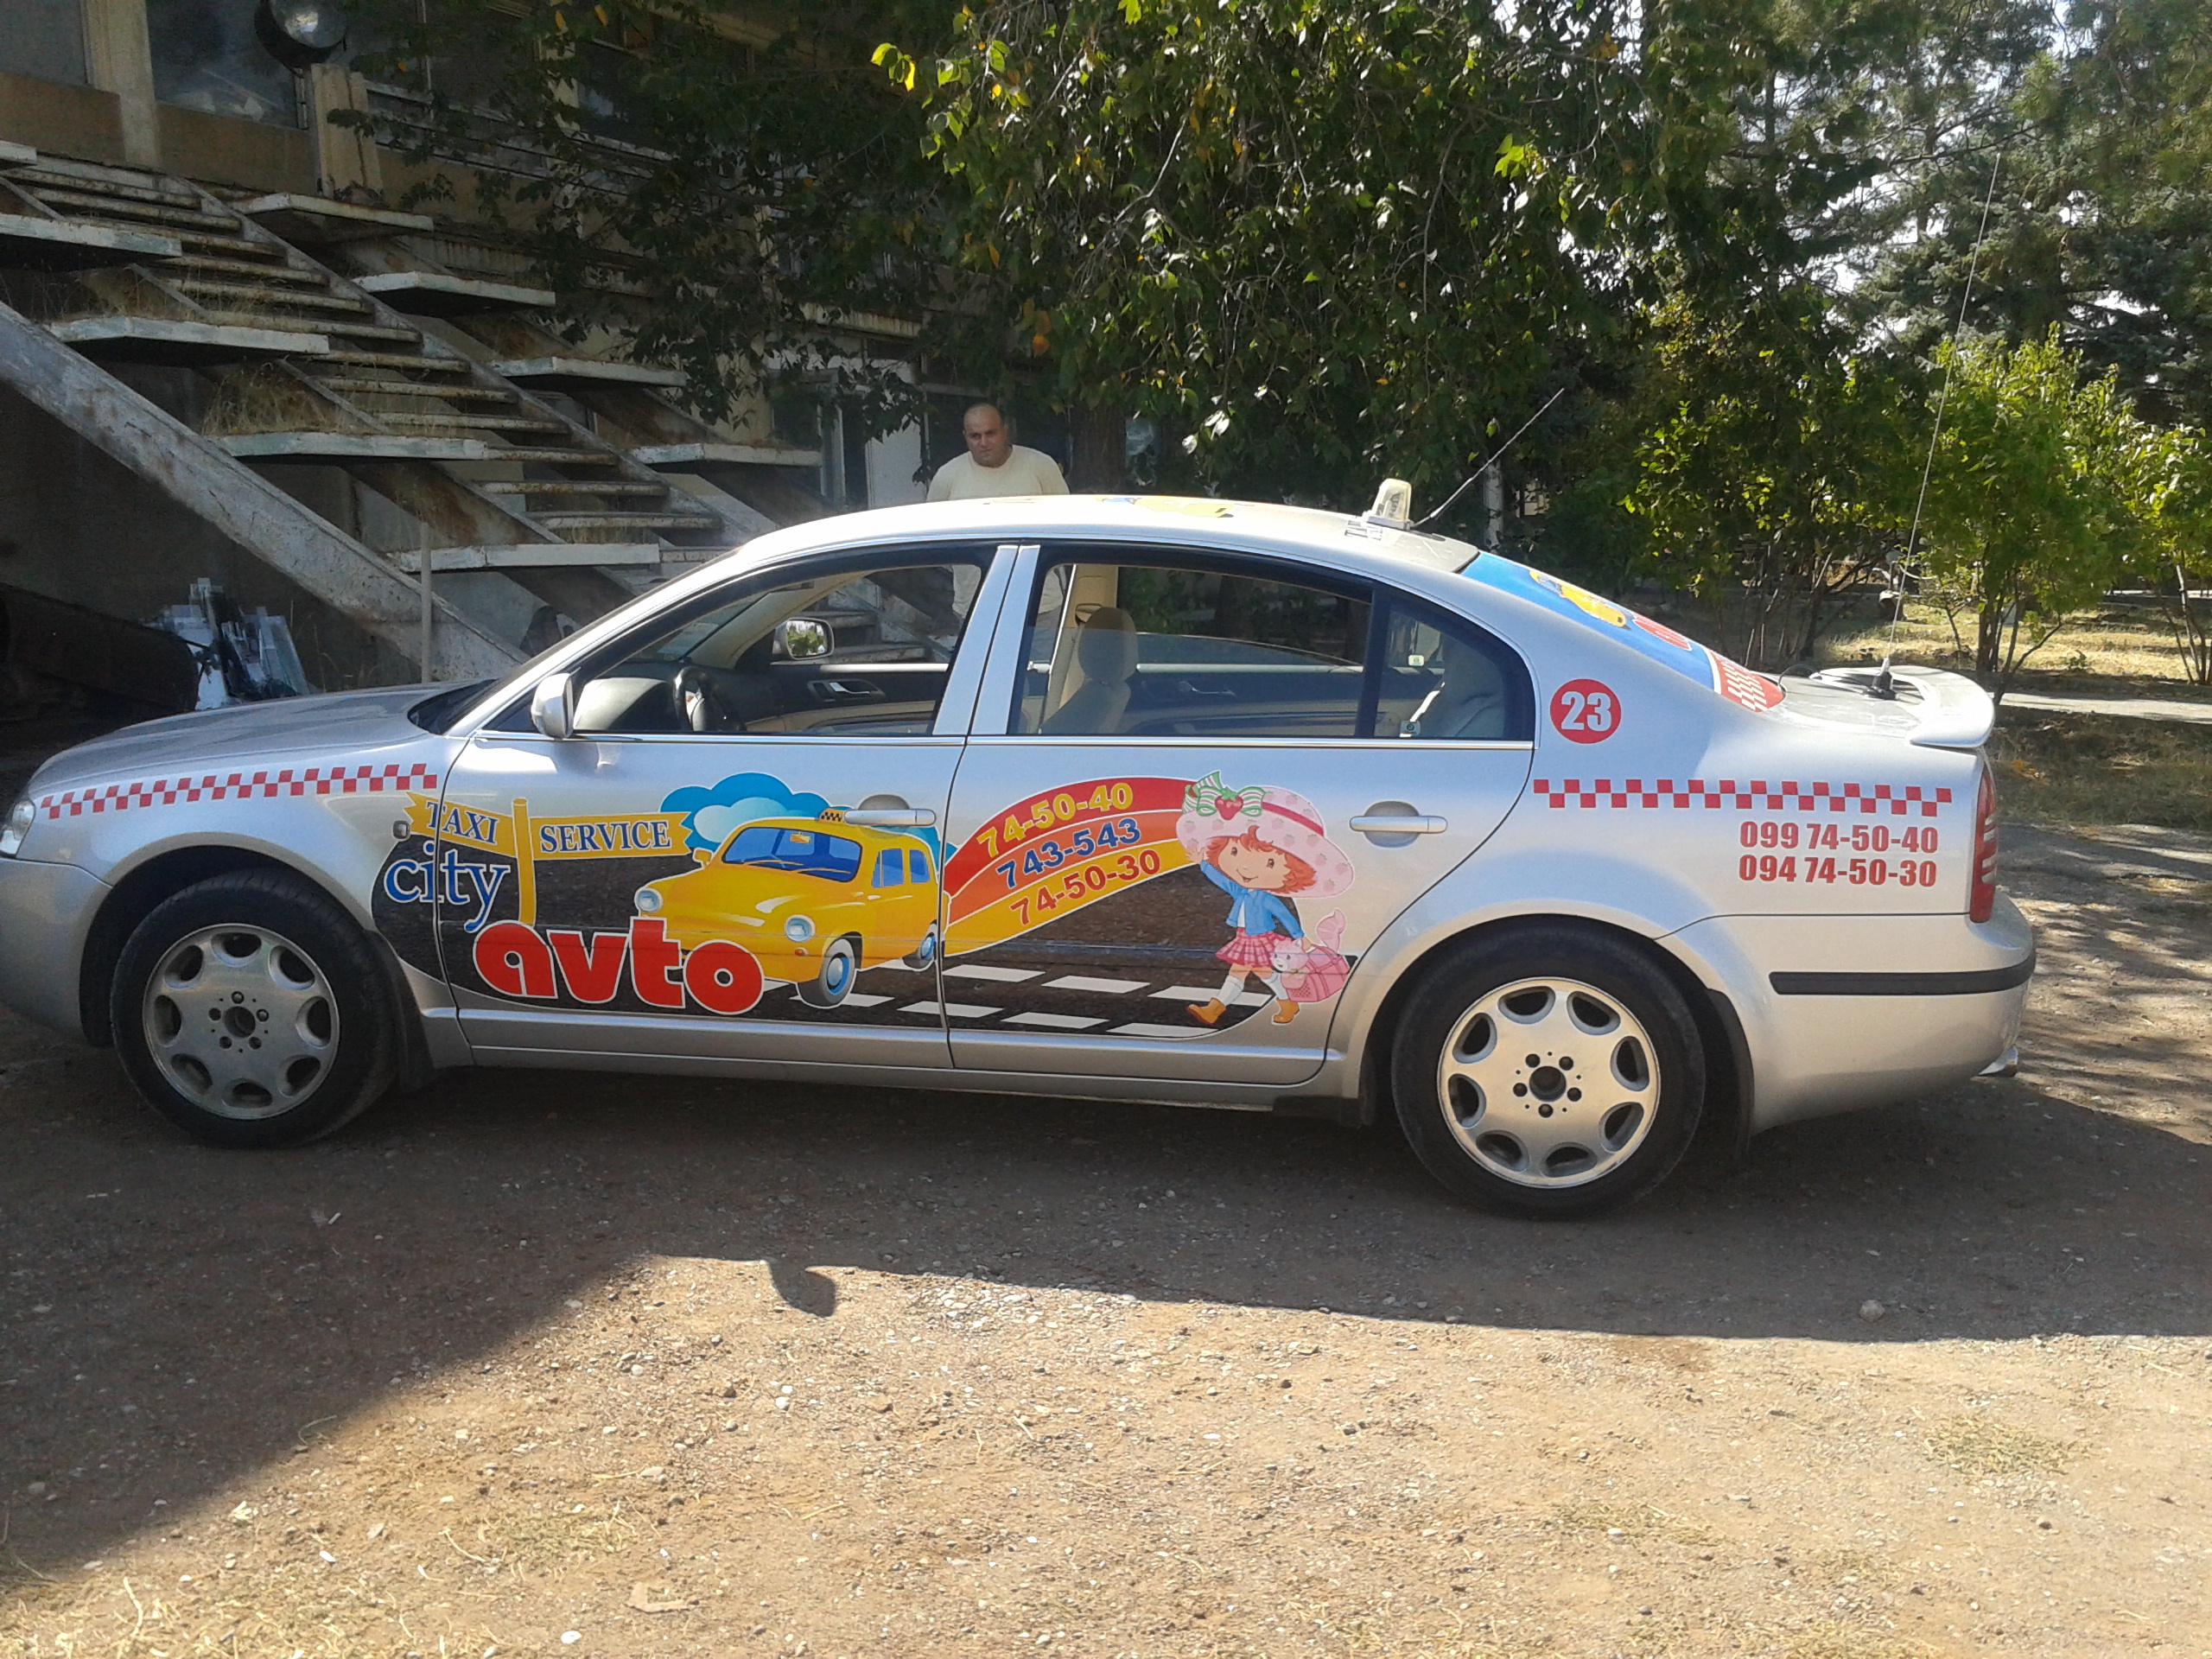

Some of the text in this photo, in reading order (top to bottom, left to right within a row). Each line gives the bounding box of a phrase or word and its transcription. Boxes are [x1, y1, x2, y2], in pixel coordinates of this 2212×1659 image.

[1560, 691, 1611, 731] 23
[425, 800, 671, 853] TAXI SERVICE
[976, 782, 1134, 859] 74-50-40
[996, 817, 1141, 889] 743-543
[1739, 821, 1939, 854] 099 74-50-40
[384, 842, 511, 932] city
[1009, 849, 1160, 926] 74-50-30
[1738, 854, 1937, 887] 094 74-50-30
[473, 917, 765, 1014] avto
